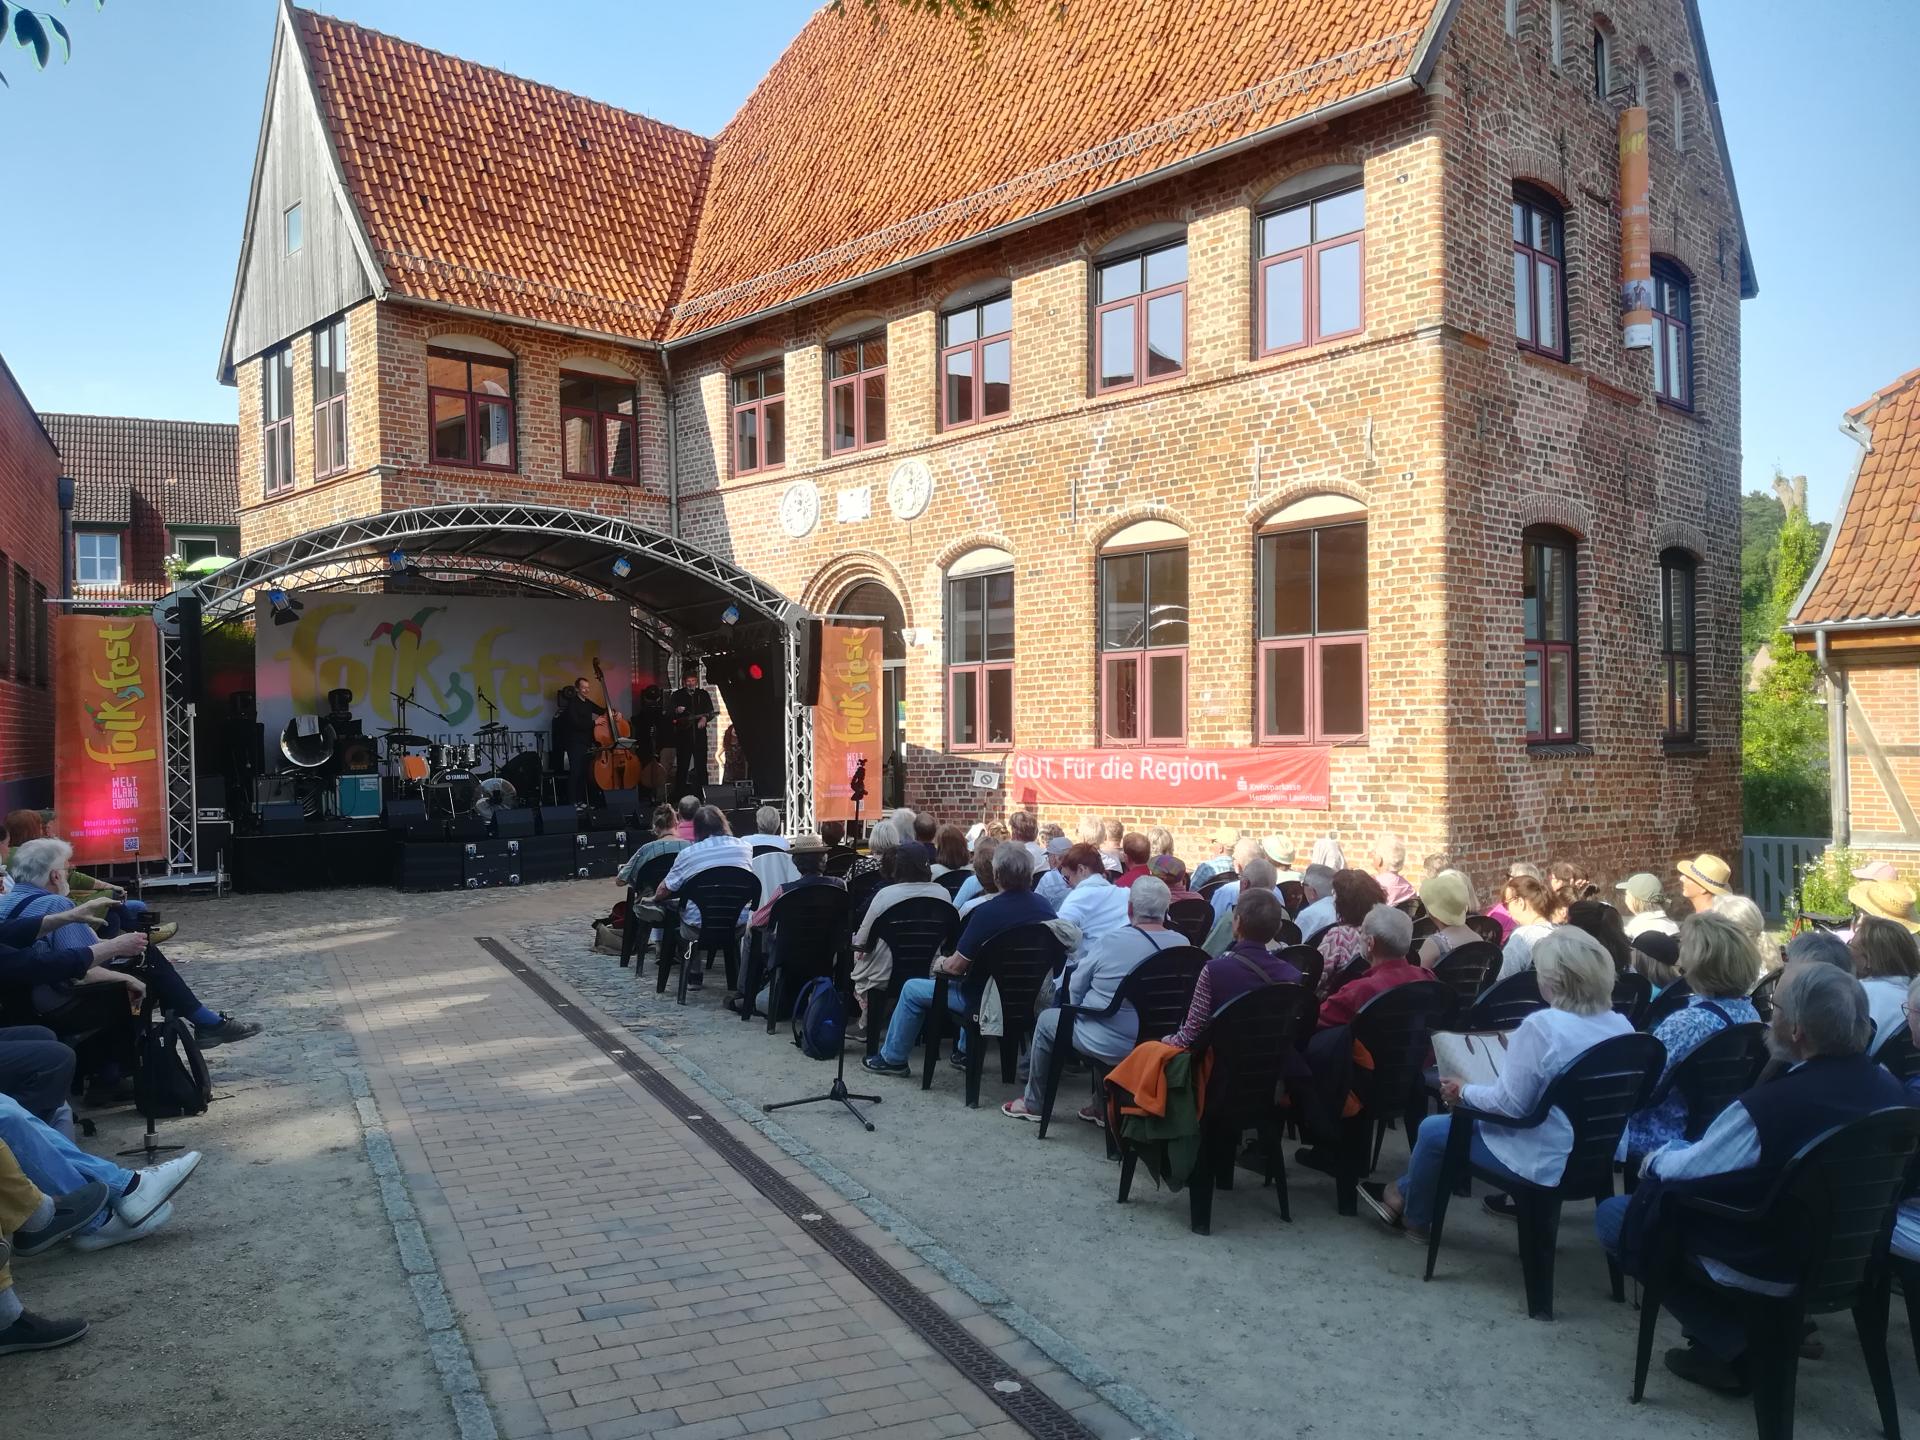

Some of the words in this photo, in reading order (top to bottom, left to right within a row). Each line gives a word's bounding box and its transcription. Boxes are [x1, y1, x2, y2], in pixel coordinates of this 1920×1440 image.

[1015, 756, 1057, 780] GUT.
[1063, 756, 1095, 780] Für
[1100, 755, 1134, 781] die
[1140, 755, 1228, 787] Region.
[112, 776, 137, 788] WELT
[112, 787, 138, 799] KLANG
[112, 797, 139, 810] EUROPA
